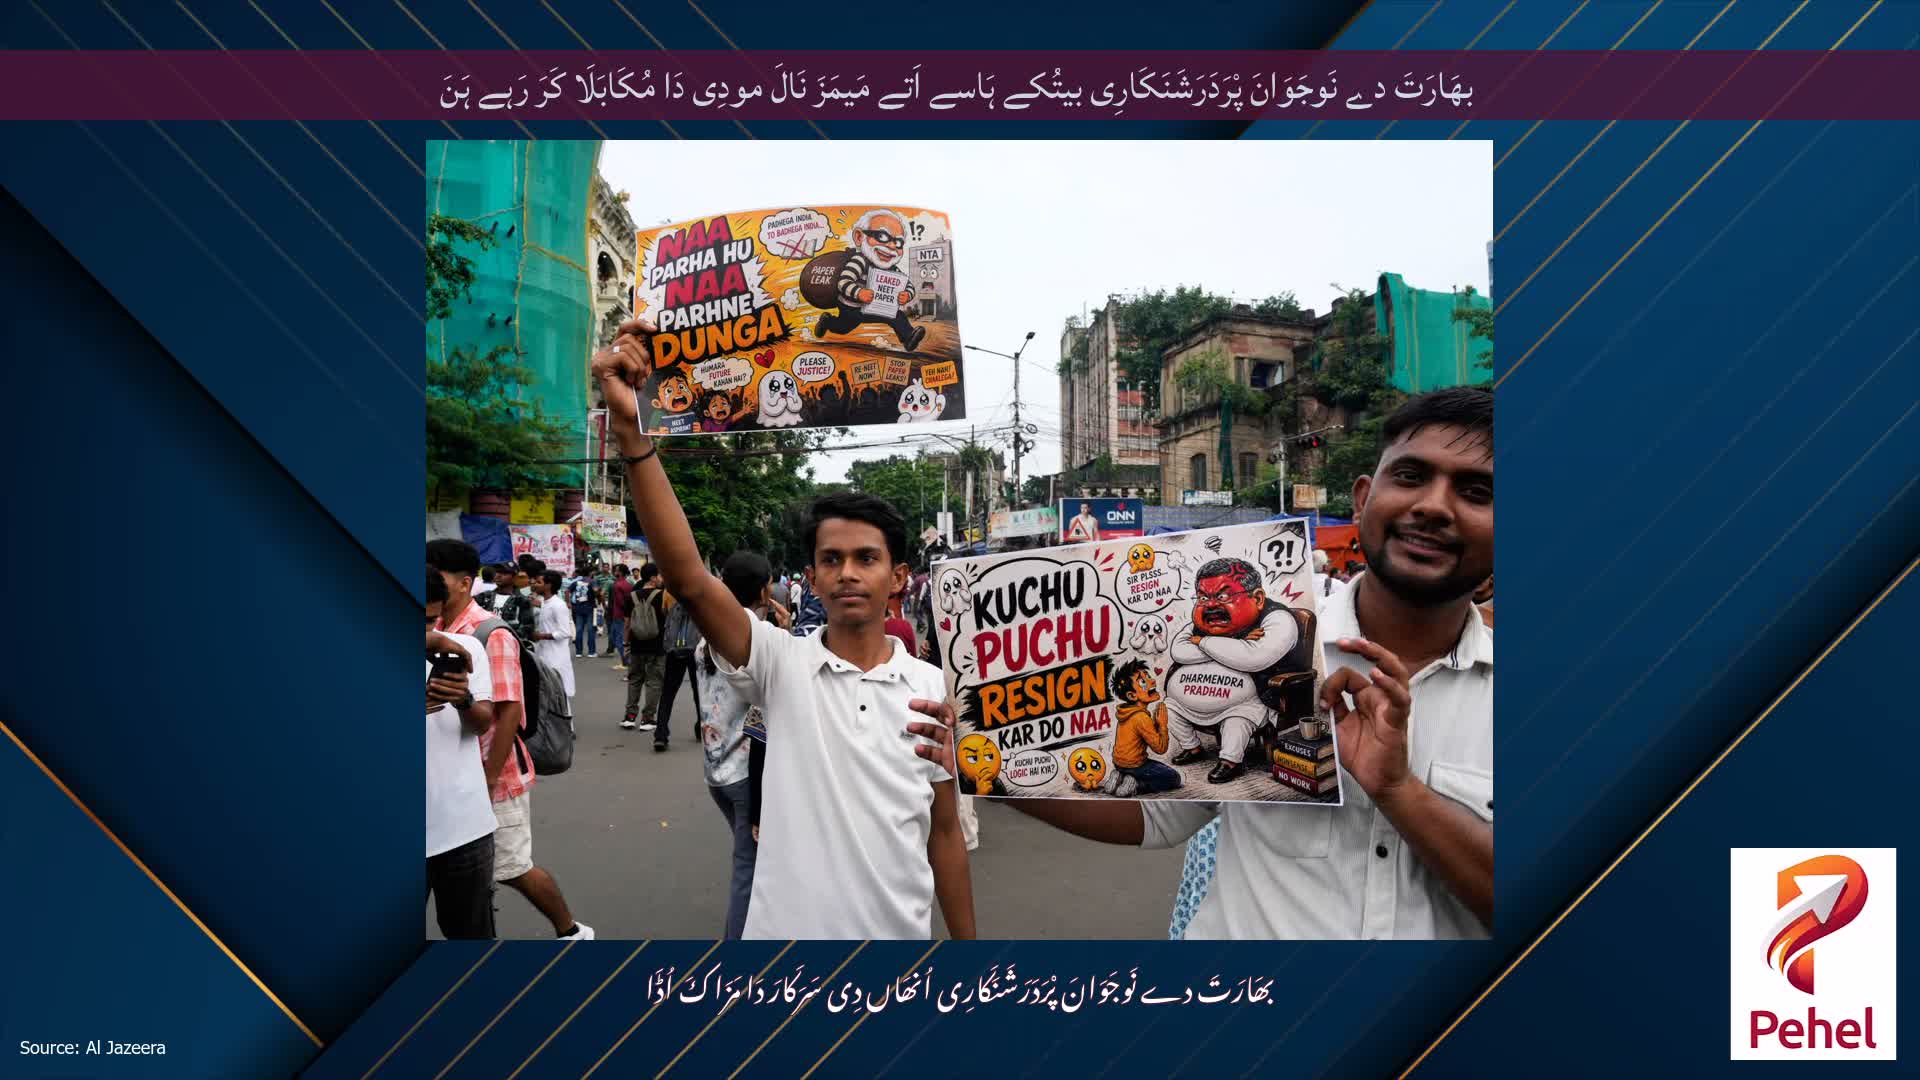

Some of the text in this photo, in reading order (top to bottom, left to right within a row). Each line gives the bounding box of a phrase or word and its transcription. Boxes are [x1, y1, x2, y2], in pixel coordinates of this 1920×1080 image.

[767, 213, 813, 230] PADHEGA INDIA
[767, 231, 776, 240] TO
[776, 224, 803, 239] BADHEGA
[909, 221, 925, 241] !?
[656, 215, 732, 263] NAA
[919, 249, 939, 260] NTA
[651, 238, 753, 288] PARHA HU
[811, 266, 836, 275] PAPER
[665, 262, 747, 310] NAA
[810, 275, 832, 285] LEAK
[875, 273, 901, 287] LEAKED
[877, 285, 895, 294] NEET
[874, 293, 895, 304] PAPER
[659, 293, 753, 333] PARHNE
[652, 305, 784, 369] DUNGA
[700, 361, 726, 374] HUMARA
[800, 357, 827, 366] PLEASE
[709, 368, 732, 380] FUTURE
[733, 373, 747, 383] HAI?
[797, 365, 831, 376] JUSTICE!
[885, 373, 907, 382] LEAKS!
[887, 366, 907, 375] PAPER
[1107, 511, 1135, 521] ONN
[1267, 540, 1295, 568] ?!
[1126, 574, 1138, 585] SIR
[1130, 579, 1159, 595] RESIGN
[973, 567, 1085, 631] KUCHU
[1127, 585, 1172, 605] KAR DO NAA
[972, 604, 1110, 680] PUCHU
[1179, 673, 1244, 689] DHARMENDRA
[978, 660, 1106, 728] RESIGN
[1183, 684, 1231, 699] PRADHAN
[998, 706, 1112, 751] KAR DO NAA
[1284, 742, 1312, 757] EXCUSES
[1014, 755, 1052, 768] KUCHU PUCHU
[1009, 764, 1055, 779] LOGIC HAI KYA?
[1278, 771, 1312, 791] NO WORK
